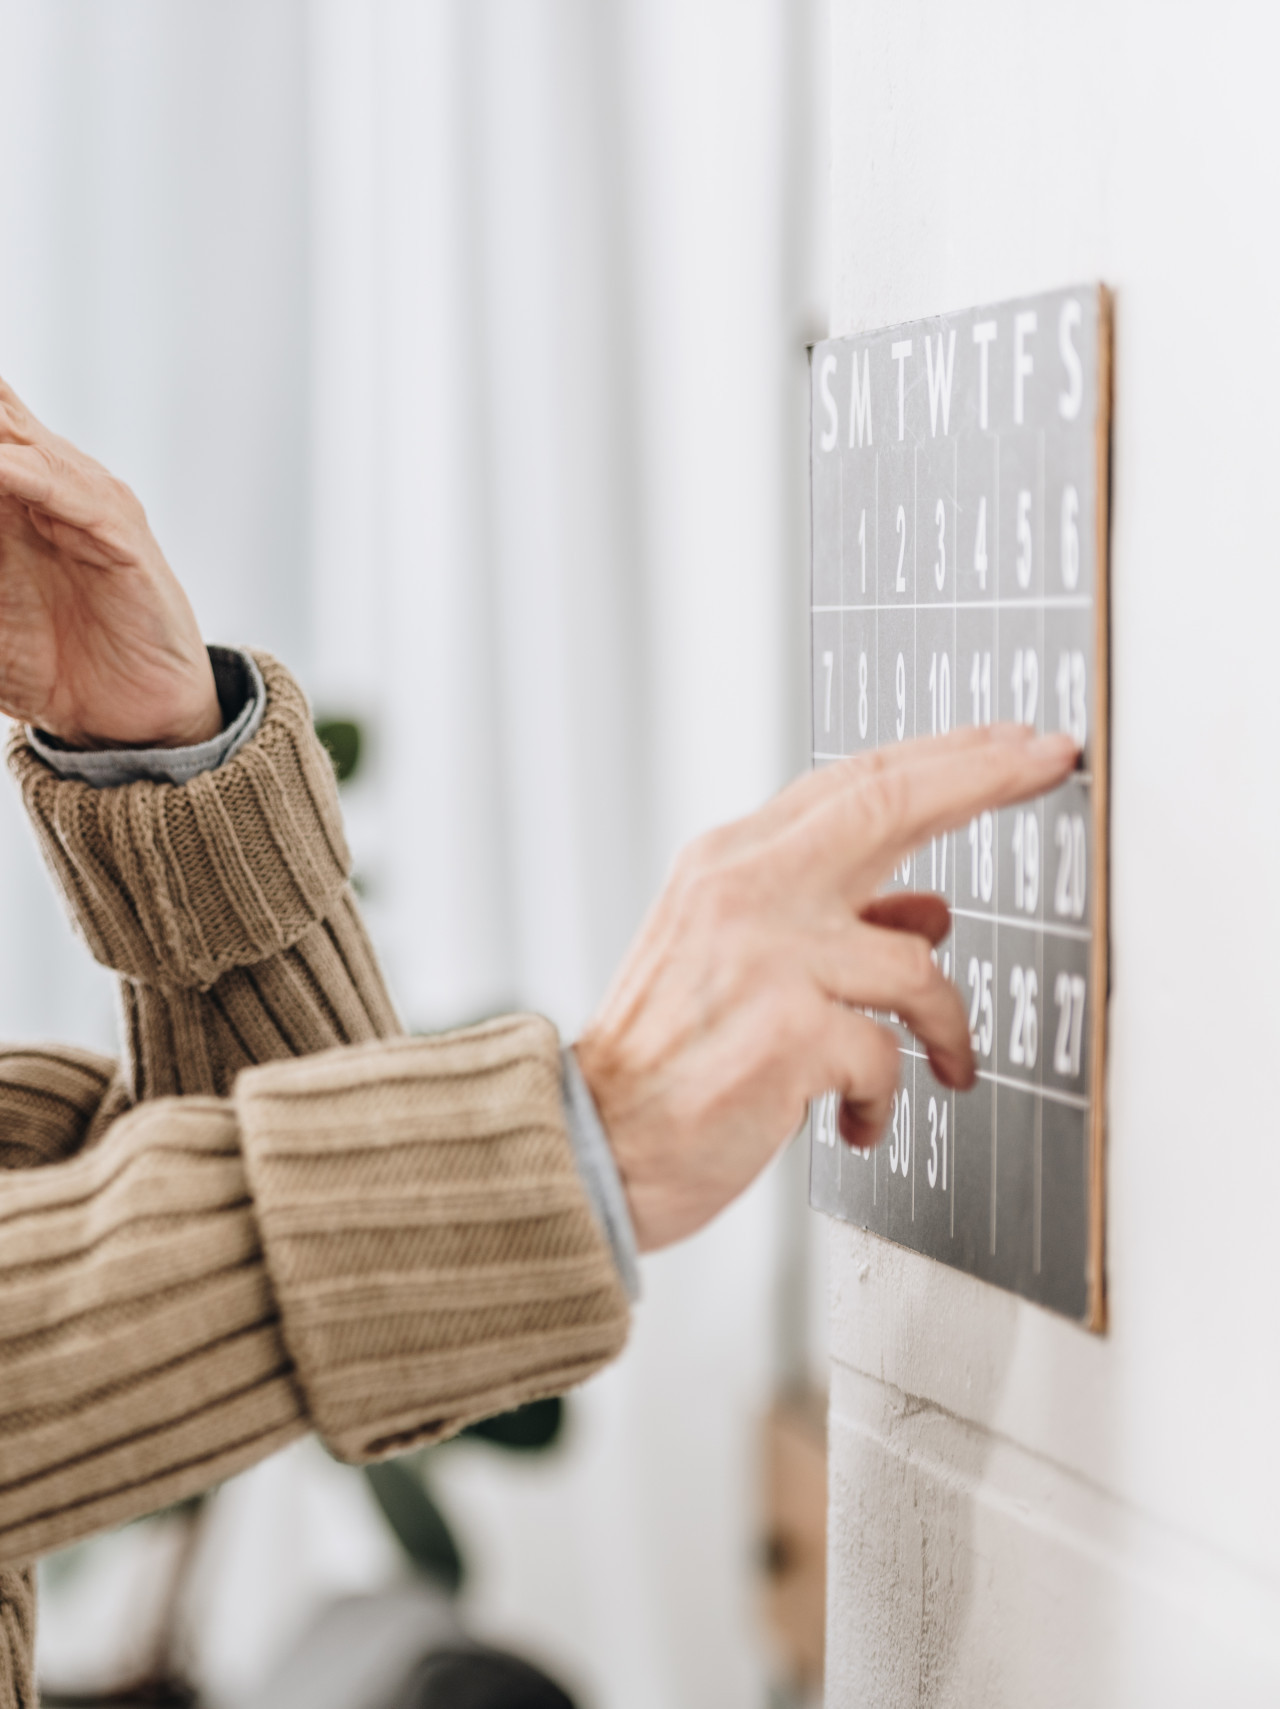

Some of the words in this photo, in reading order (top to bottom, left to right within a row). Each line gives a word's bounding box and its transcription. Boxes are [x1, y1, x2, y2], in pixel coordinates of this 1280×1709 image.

[821, 354, 838, 452] S
[849, 348, 872, 448] M
[892, 340, 912, 441] T
[925, 329, 956, 438] W
[973, 320, 997, 430] T
[1014, 311, 1037, 425] F
[1058, 299, 1083, 420] S
[858, 508, 866, 593] 1
[896, 505, 906, 592] 2
[935, 498, 945, 591] 3
[974, 496, 988, 590] 4
[1017, 491, 1032, 589] 5
[1061, 486, 1079, 589] 6
[823, 651, 833, 732] 7
[858, 652, 867, 739] 8
[896, 652, 905, 741] 9
[929, 652, 950, 737] 10
[971, 651, 990, 728] 11
[1012, 649, 1038, 725] 12
[1056, 650, 1087, 753] 13
[969, 811, 993, 902] 18
[1013, 811, 1039, 914] 19
[1055, 814, 1086, 919] 20
[969, 957, 993, 1057] 25
[1010, 965, 1038, 1069] 26
[1054, 971, 1086, 1078] 27
[889, 1088, 910, 1177] 30
[927, 1096, 947, 1191] 31
